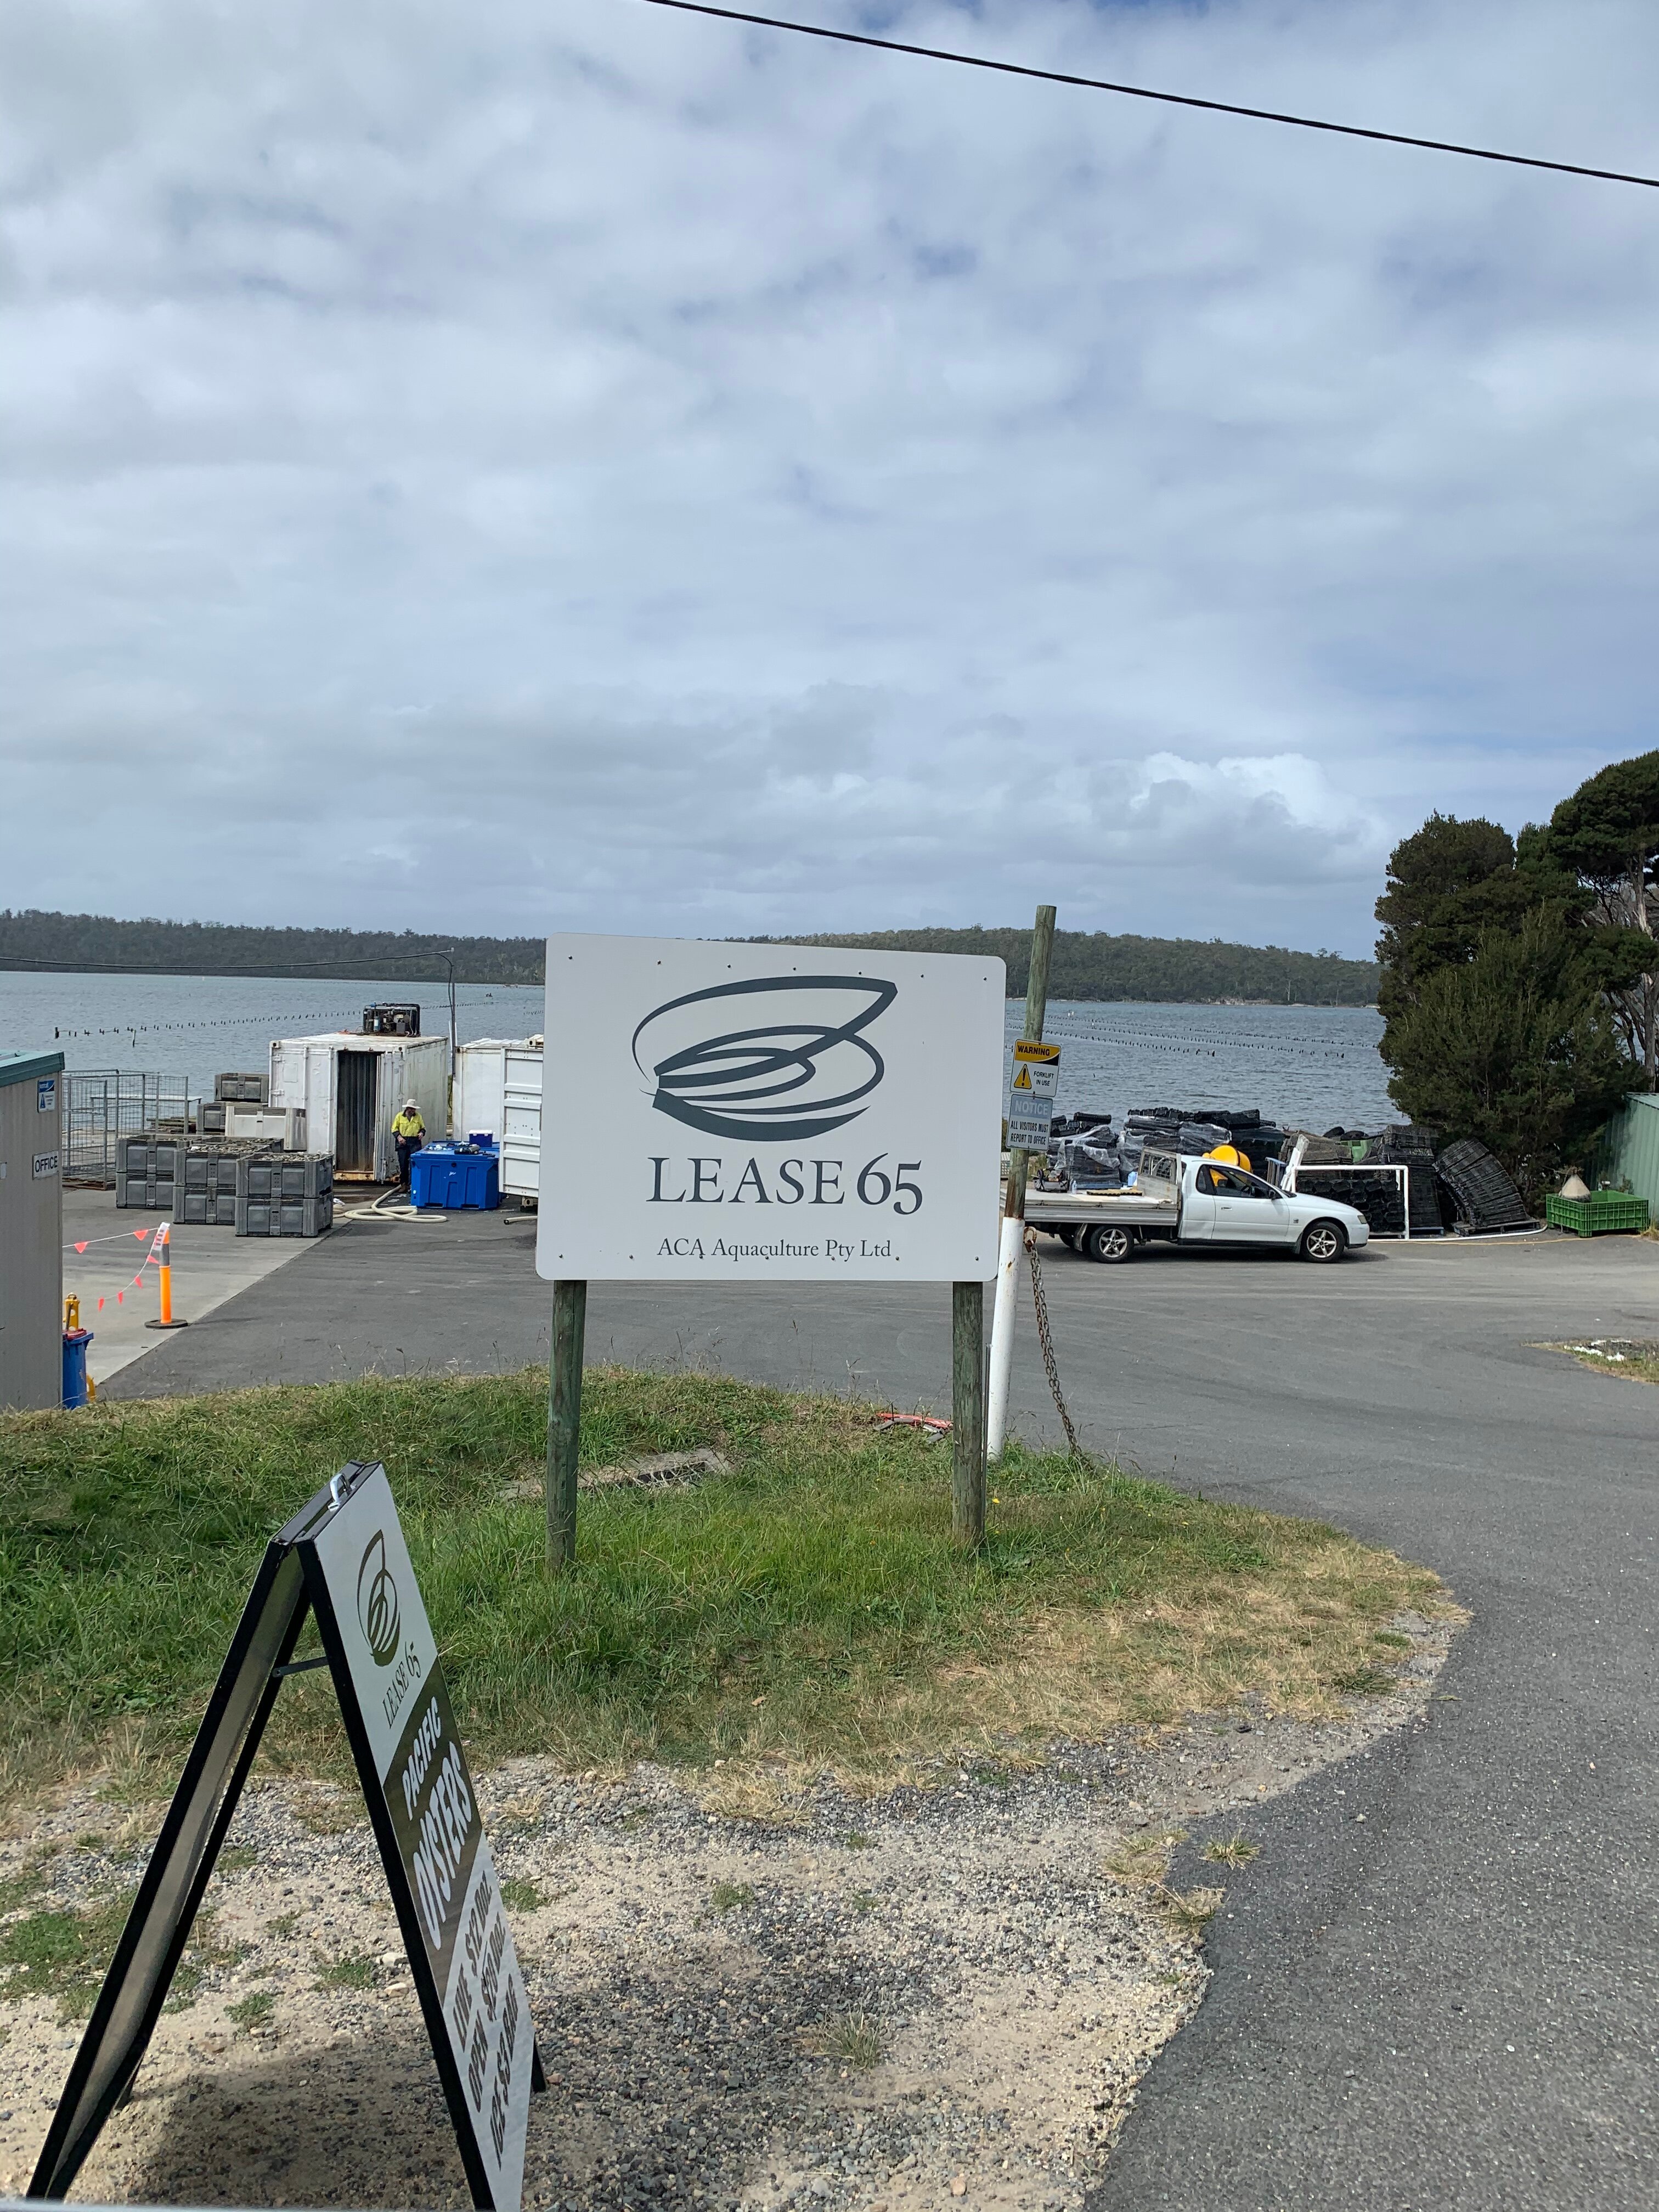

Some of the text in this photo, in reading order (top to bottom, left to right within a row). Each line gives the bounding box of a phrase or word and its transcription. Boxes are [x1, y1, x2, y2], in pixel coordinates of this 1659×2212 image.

[1017, 1045, 1050, 1057] WARNING
[1034, 1070, 1054, 1079] FORKLIFT
[1010, 1120, 1049, 1133] ALL VISITORS MUST
[1015, 1100, 1048, 1115] NOTICE
[1011, 1133, 1046, 1145] REPORT TO OFFICE
[35, 1155, 58, 1173] OFFICE
[646, 1152, 923, 1215] LEASE 65
[657, 1238, 891, 1262] ACA Aquaculture Pty Ltd
[382, 1641, 421, 1729] LEASE 65
[402, 1696, 441, 1821] PACIFIC
[413, 1741, 472, 1951] OYSTERS
[453, 1962, 473, 2053] LIVE
[465, 1908, 482, 1977] $12
[469, 2009, 488, 2113] OPEN
[481, 1953, 498, 2022] $20
[490, 1973, 518, 2172] ICE $3 BAG
